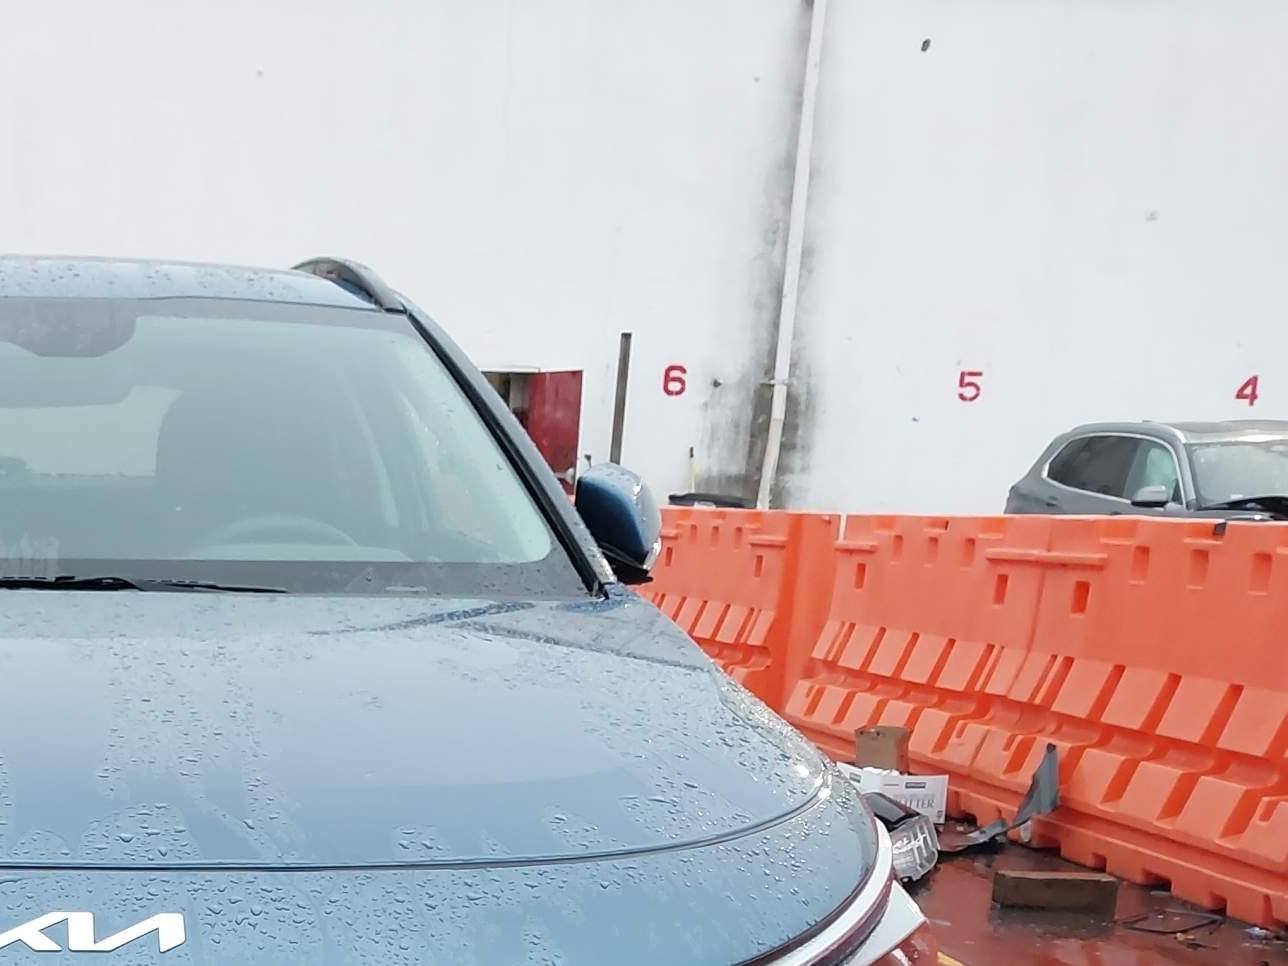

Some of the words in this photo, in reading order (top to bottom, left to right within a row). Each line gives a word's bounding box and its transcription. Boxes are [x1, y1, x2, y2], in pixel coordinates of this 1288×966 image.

[662, 364, 687, 397] 6
[958, 370, 981, 402] 5
[1235, 375, 1260, 406] 4
